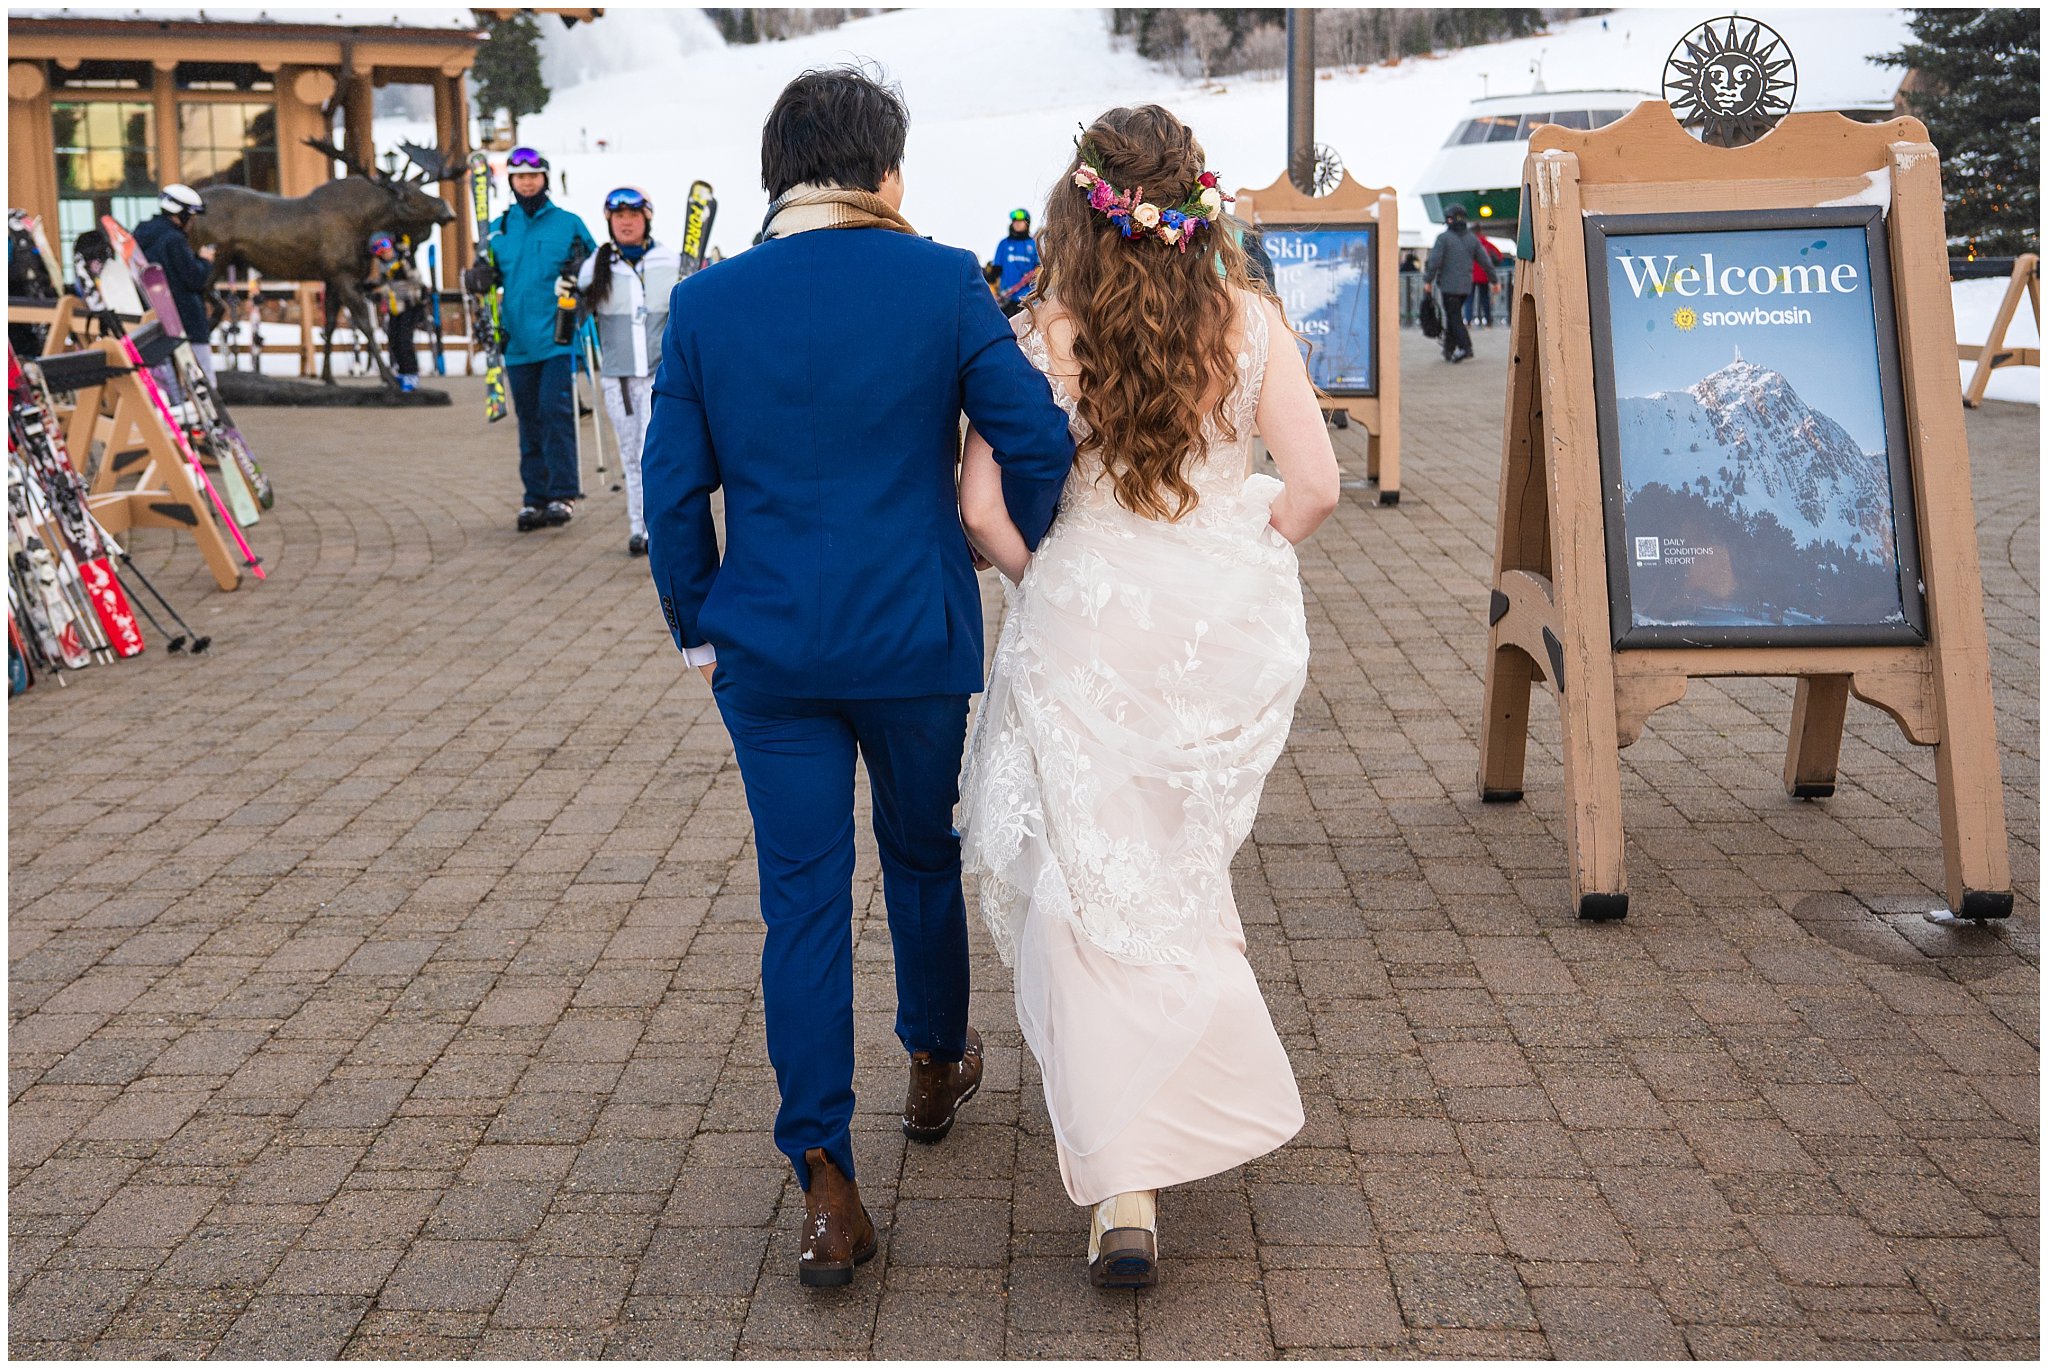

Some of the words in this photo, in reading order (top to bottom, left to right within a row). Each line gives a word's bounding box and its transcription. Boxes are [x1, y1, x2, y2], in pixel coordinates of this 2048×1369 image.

[475, 175, 488, 221] FORCE
[684, 204, 703, 258] FORCE
[1265, 237, 1318, 262] Skip
[1274, 263, 1303, 283] he
[1616, 253, 1859, 298] Welcome
[1702, 306, 1812, 327] snowbasin
[1292, 319, 1330, 335] nes
[1663, 538, 1685, 546] DAILY
[1664, 547, 1714, 556] CONDITIONS
[1665, 557, 1695, 565] REPORT
